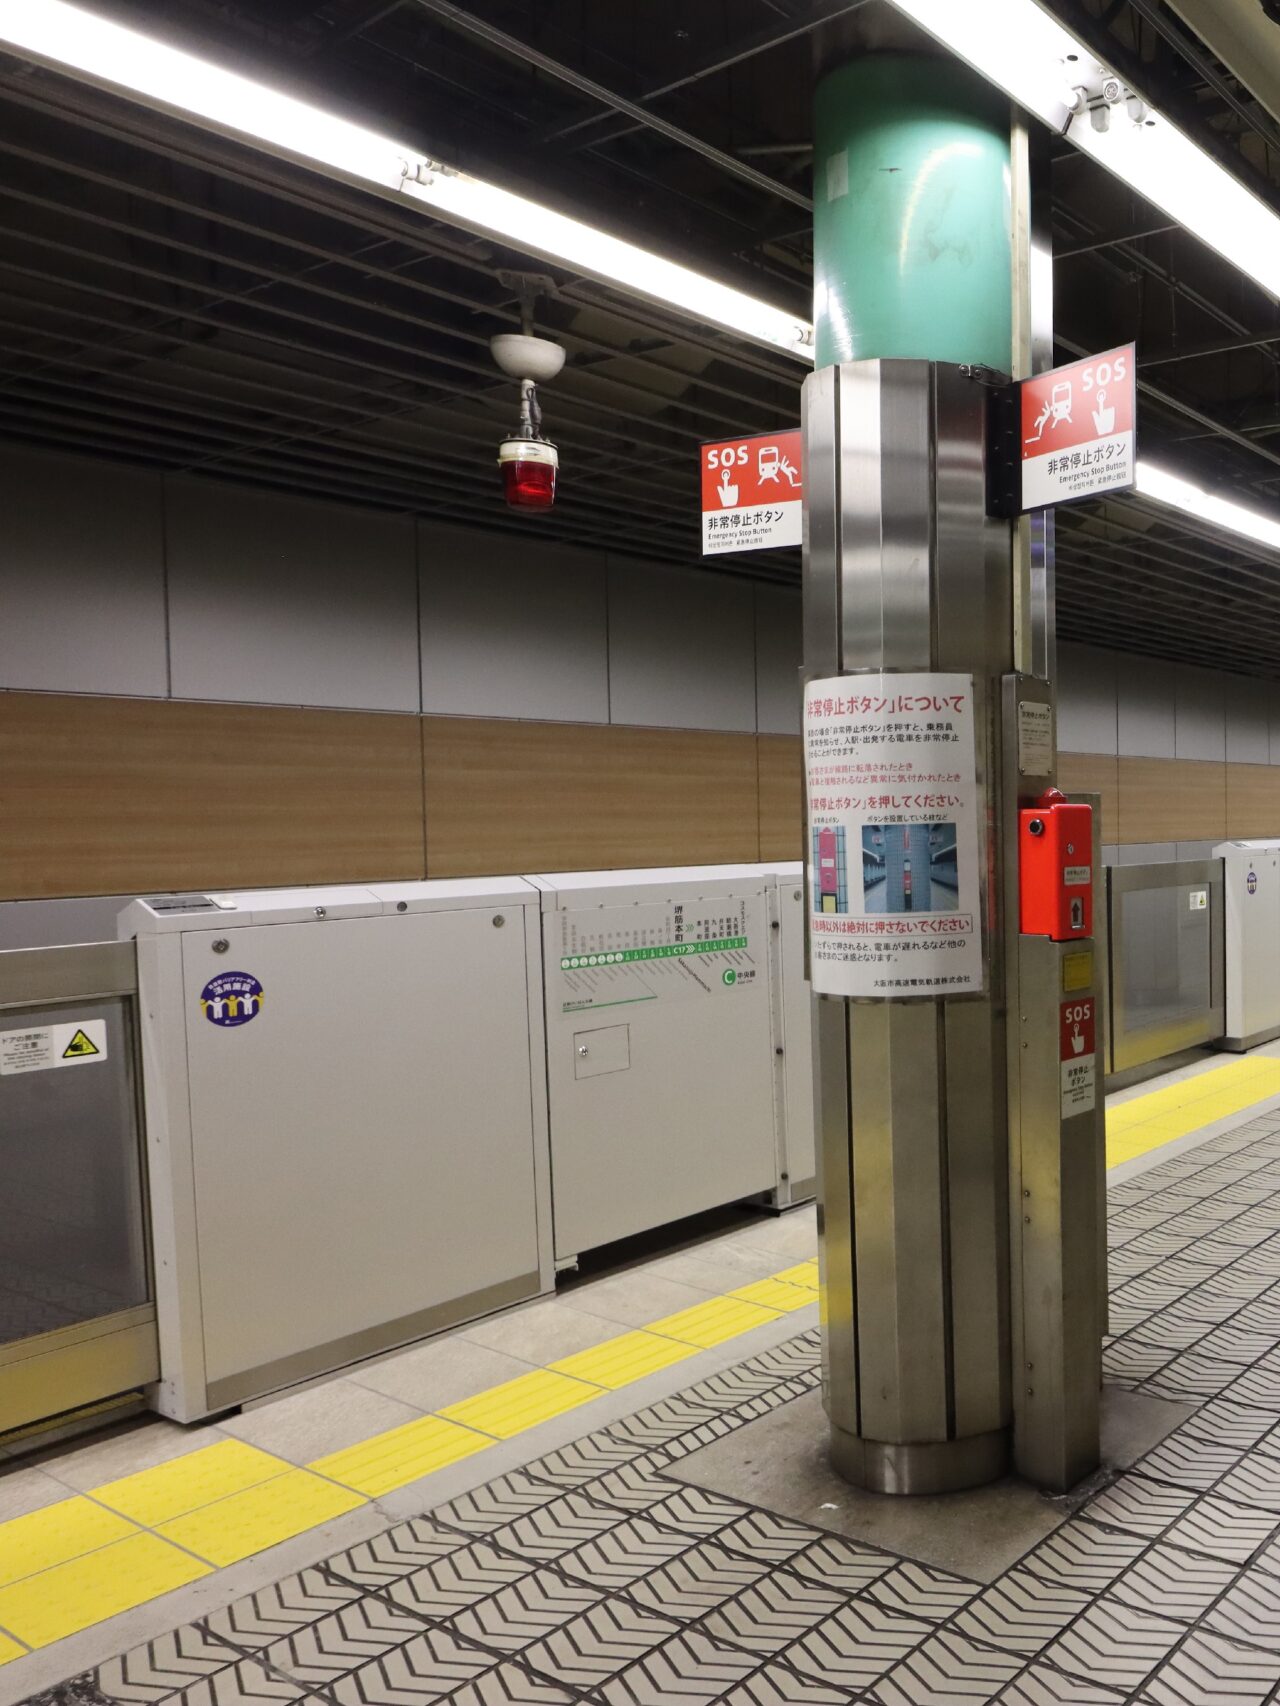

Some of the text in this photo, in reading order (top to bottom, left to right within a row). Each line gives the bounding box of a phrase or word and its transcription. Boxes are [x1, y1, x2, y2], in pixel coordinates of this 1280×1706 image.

[1082, 356, 1126, 392] SOS
[707, 445, 749, 470] SOS
[1048, 443, 1126, 475] 非常停止ボタン
[1060, 462, 1127, 483] Emergency Stop Button
[708, 510, 784, 531] 非常停止ボタン
[739, 528, 752, 537] Stop
[753, 527, 772, 535] Button
[674, 905, 684, 942] 堺筋本町
[673, 946, 686, 955] C17
[1065, 1004, 1091, 1024] SOS
